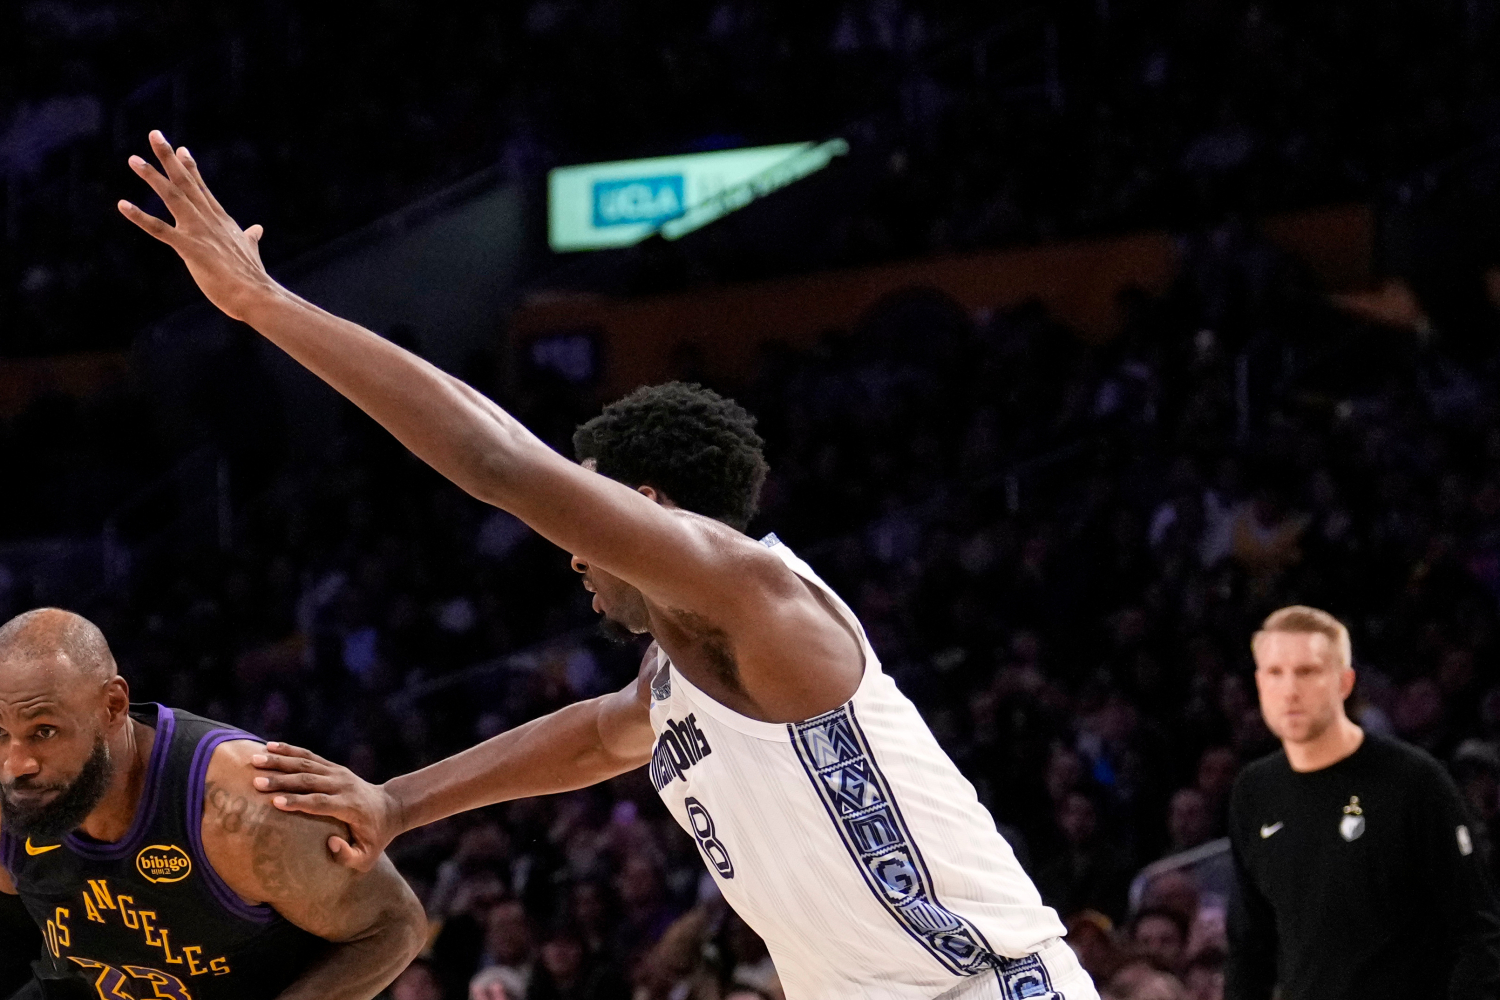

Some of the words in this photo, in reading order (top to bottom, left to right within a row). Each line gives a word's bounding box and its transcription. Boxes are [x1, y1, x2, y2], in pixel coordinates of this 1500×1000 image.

[141, 855, 187, 872] bibigo
[685, 797, 734, 879] 8
[82, 879, 231, 976] ANGELES
